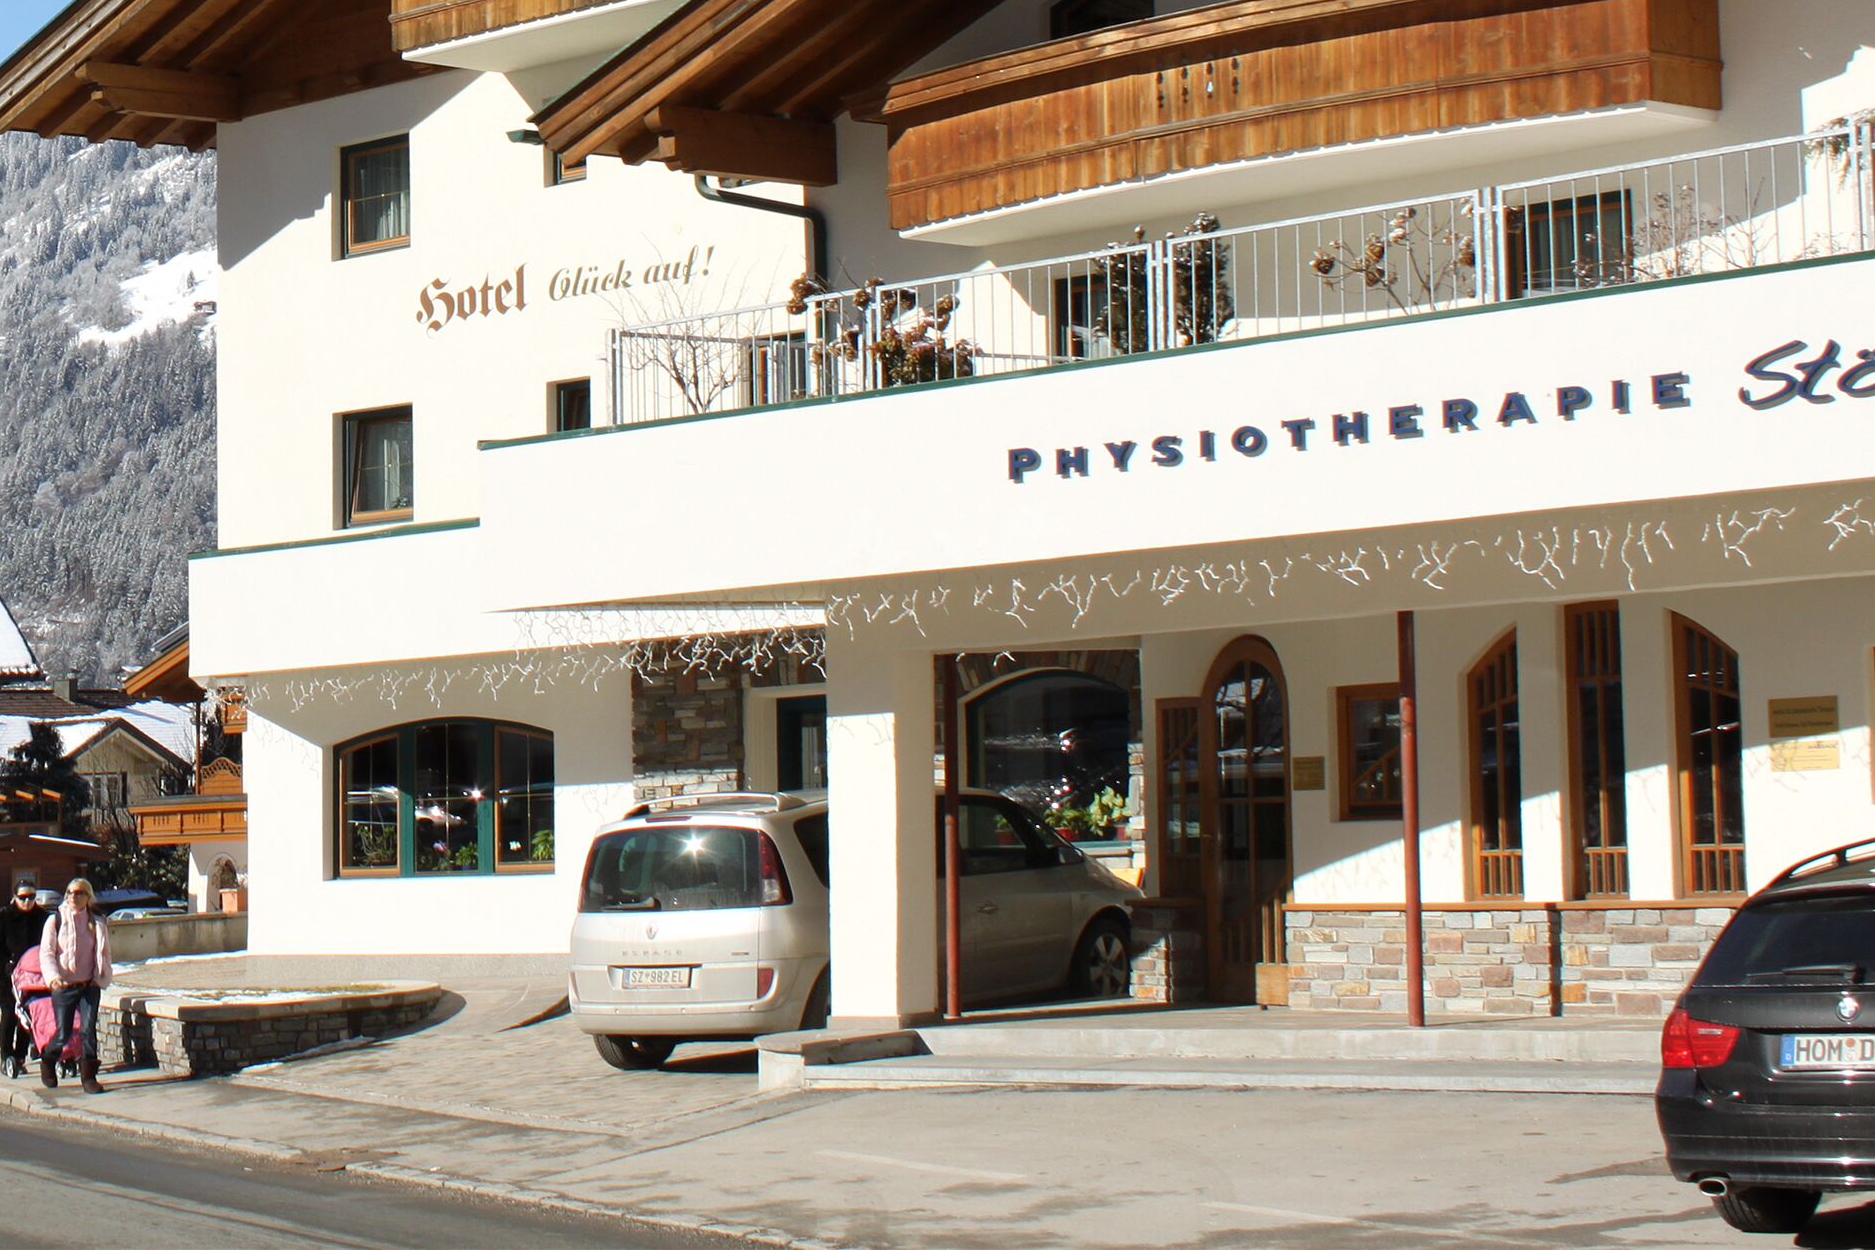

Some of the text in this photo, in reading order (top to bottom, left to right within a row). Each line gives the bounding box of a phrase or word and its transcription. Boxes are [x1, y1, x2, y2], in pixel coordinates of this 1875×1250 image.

[416, 262, 529, 338] Hotel
[548, 259, 633, 302] Glück
[1008, 371, 1691, 482] PHYSIOTHERAPIE
[631, 970, 684, 983] SZ 982 EL
[1795, 1038, 1843, 1062] HOM
